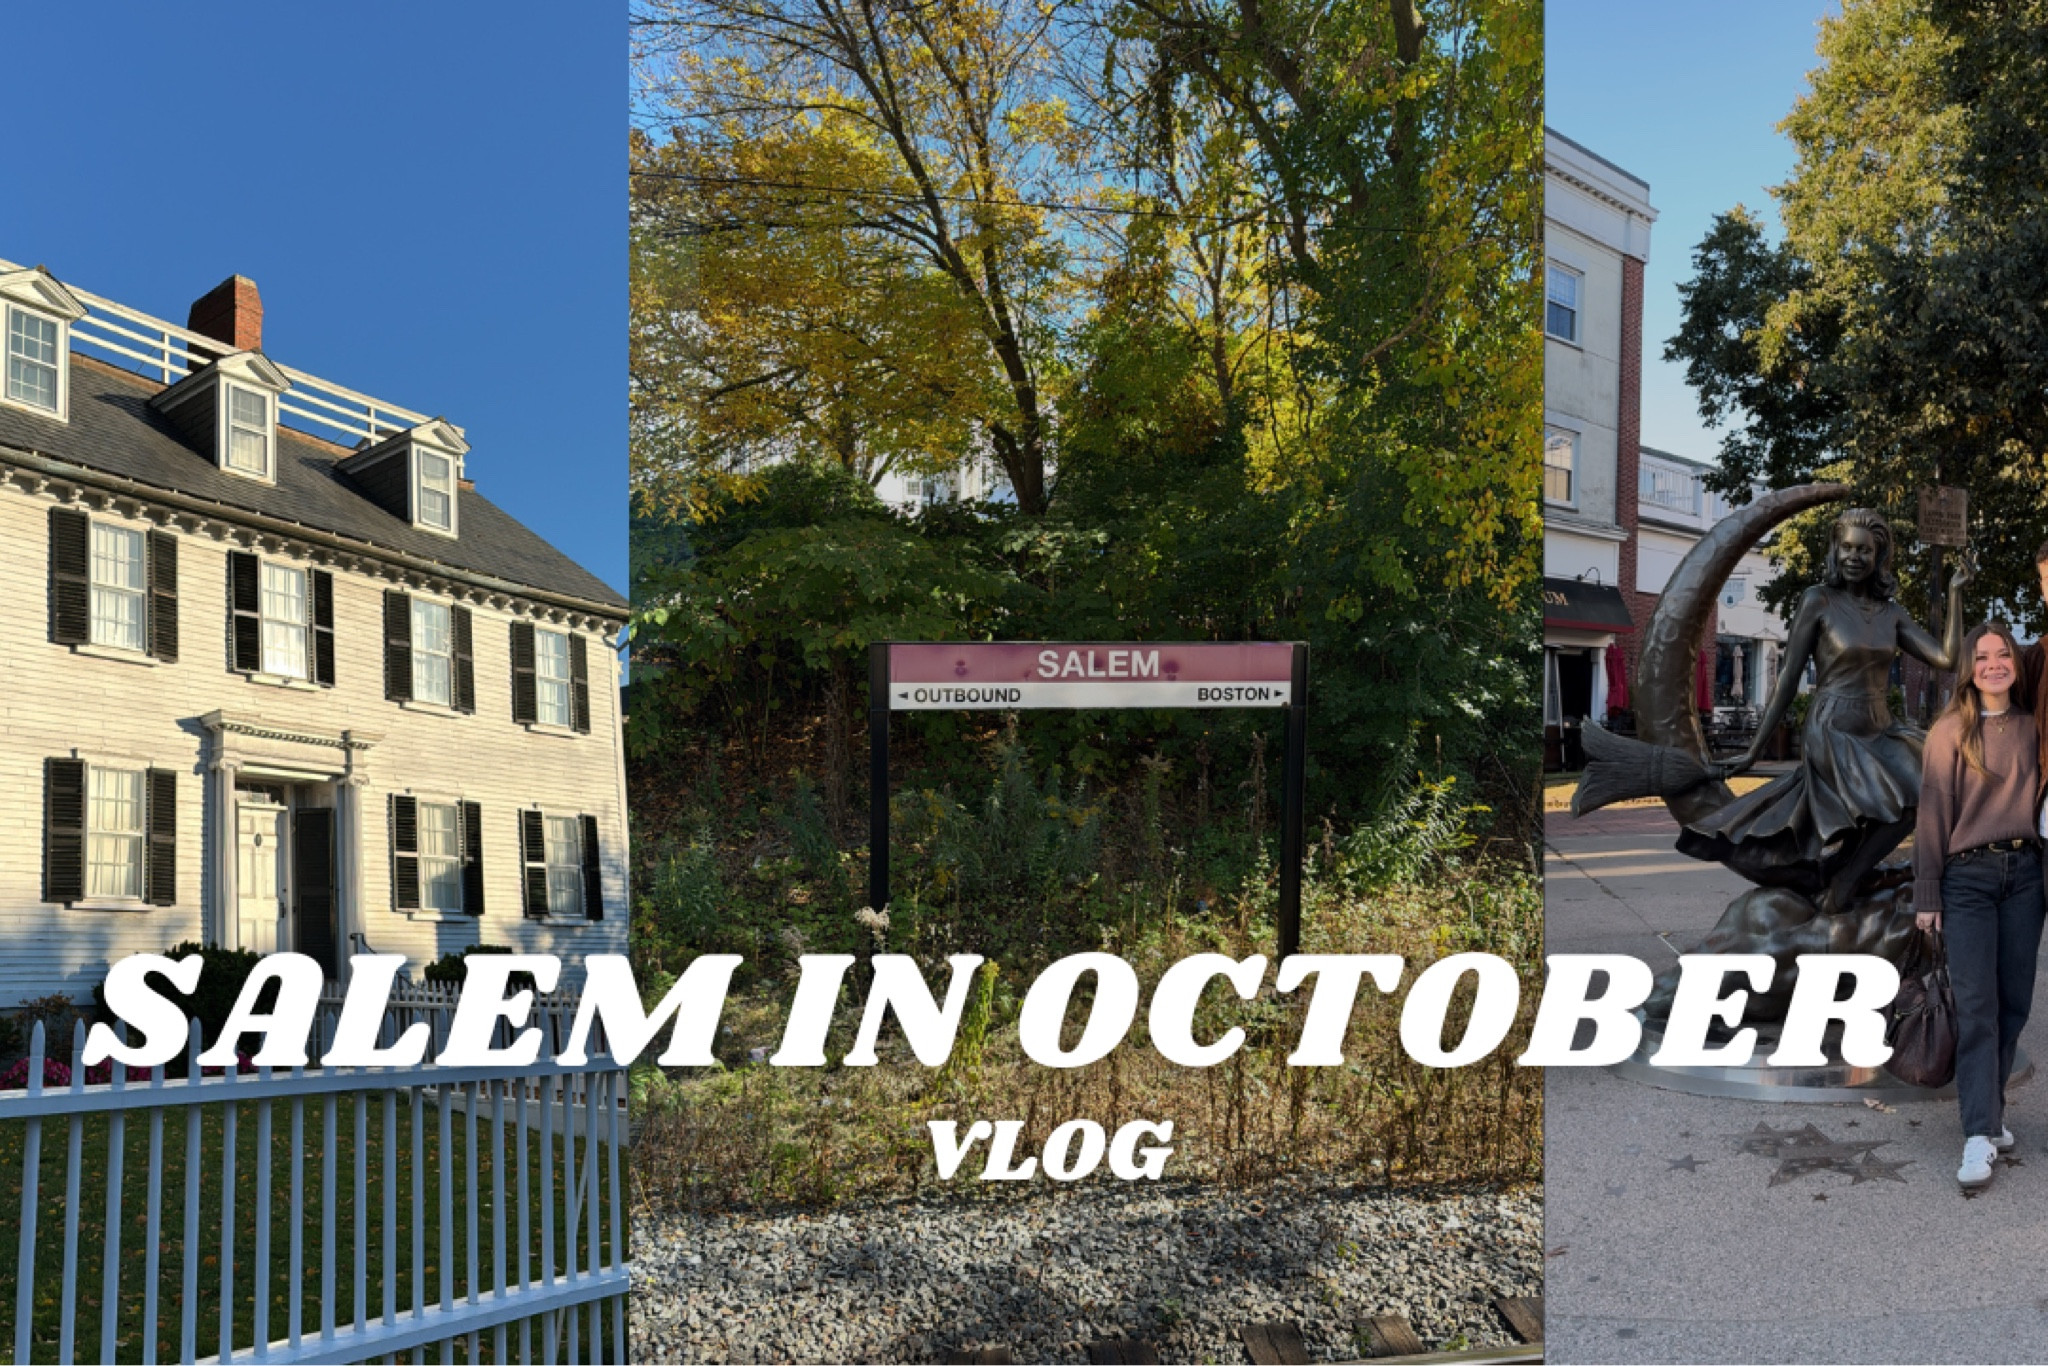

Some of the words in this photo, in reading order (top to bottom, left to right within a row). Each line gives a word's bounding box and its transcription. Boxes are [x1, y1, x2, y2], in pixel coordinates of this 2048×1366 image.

[1036, 650, 1160, 678] SALEM
[914, 687, 1021, 703] OUTBOUND
[1197, 687, 1270, 701] BOSTON
